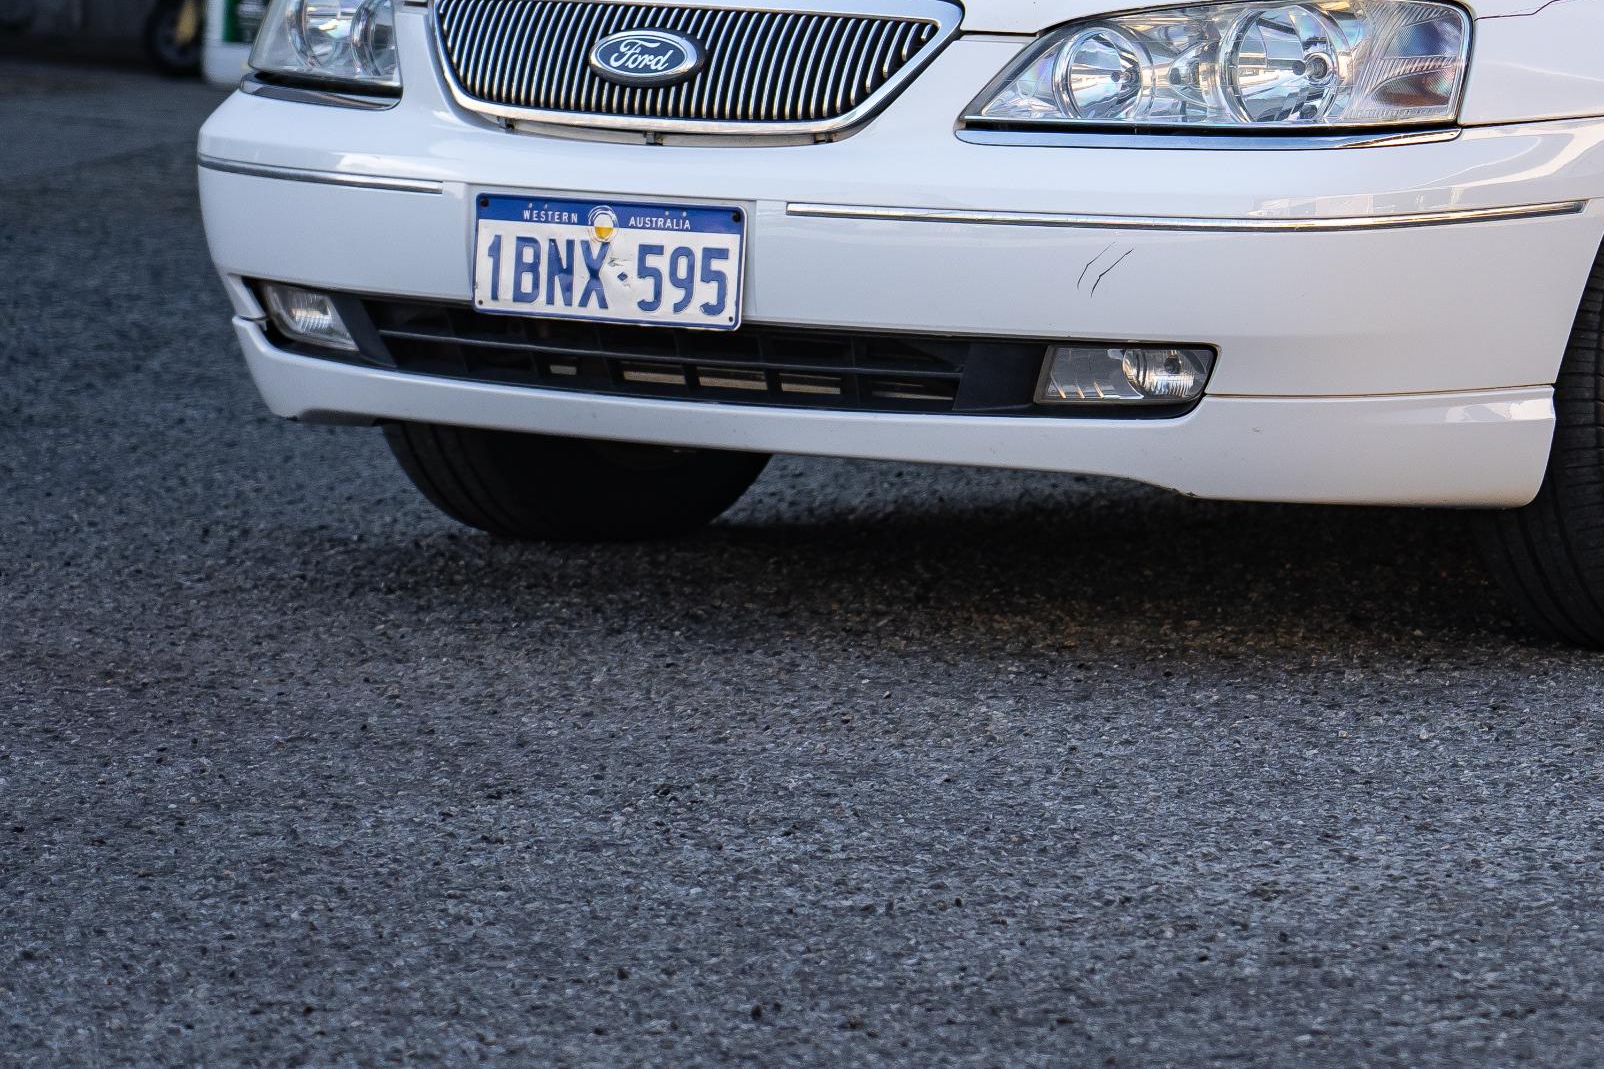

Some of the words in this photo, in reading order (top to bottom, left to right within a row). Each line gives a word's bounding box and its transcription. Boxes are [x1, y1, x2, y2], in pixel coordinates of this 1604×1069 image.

[609, 39, 674, 70] Ford
[523, 209, 578, 224] WESTERN
[628, 216, 691, 231] AUSTRALIA
